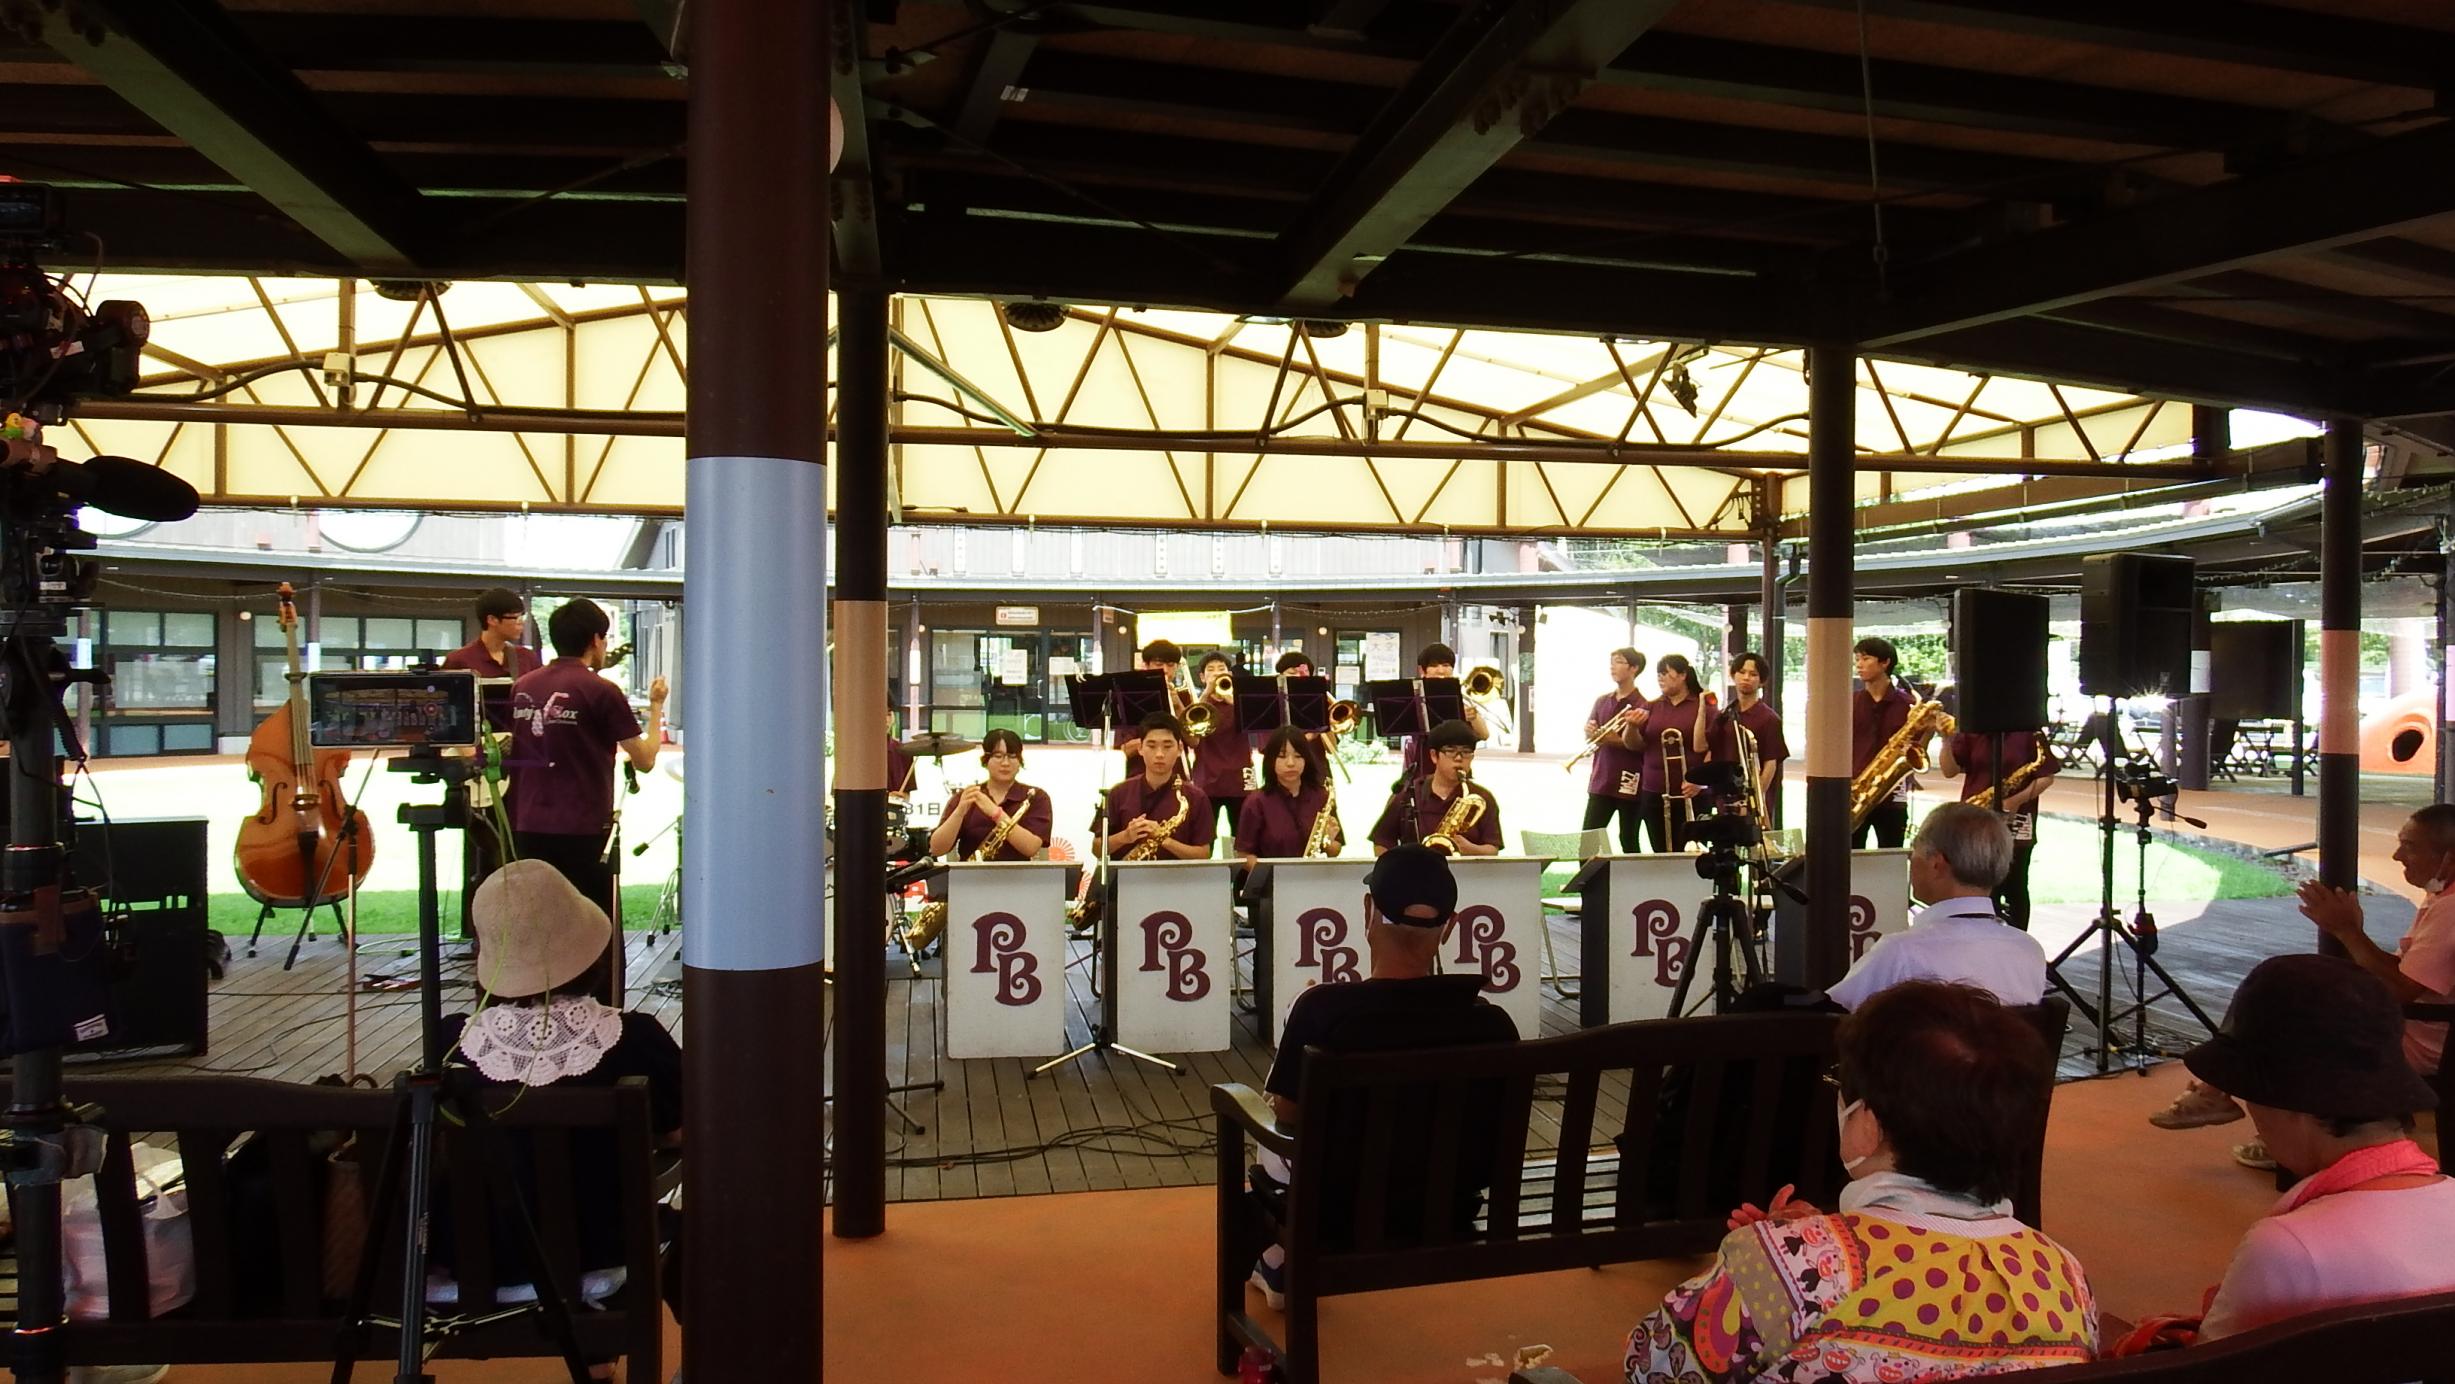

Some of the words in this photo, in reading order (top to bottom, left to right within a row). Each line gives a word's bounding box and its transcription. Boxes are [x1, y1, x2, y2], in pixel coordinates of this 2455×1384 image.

[971, 911, 1042, 1006] PB
[1139, 910, 1211, 1002] PB
[1294, 907, 1363, 984] PB
[1454, 904, 1521, 994] PB
[1631, 899, 1691, 988] PB
